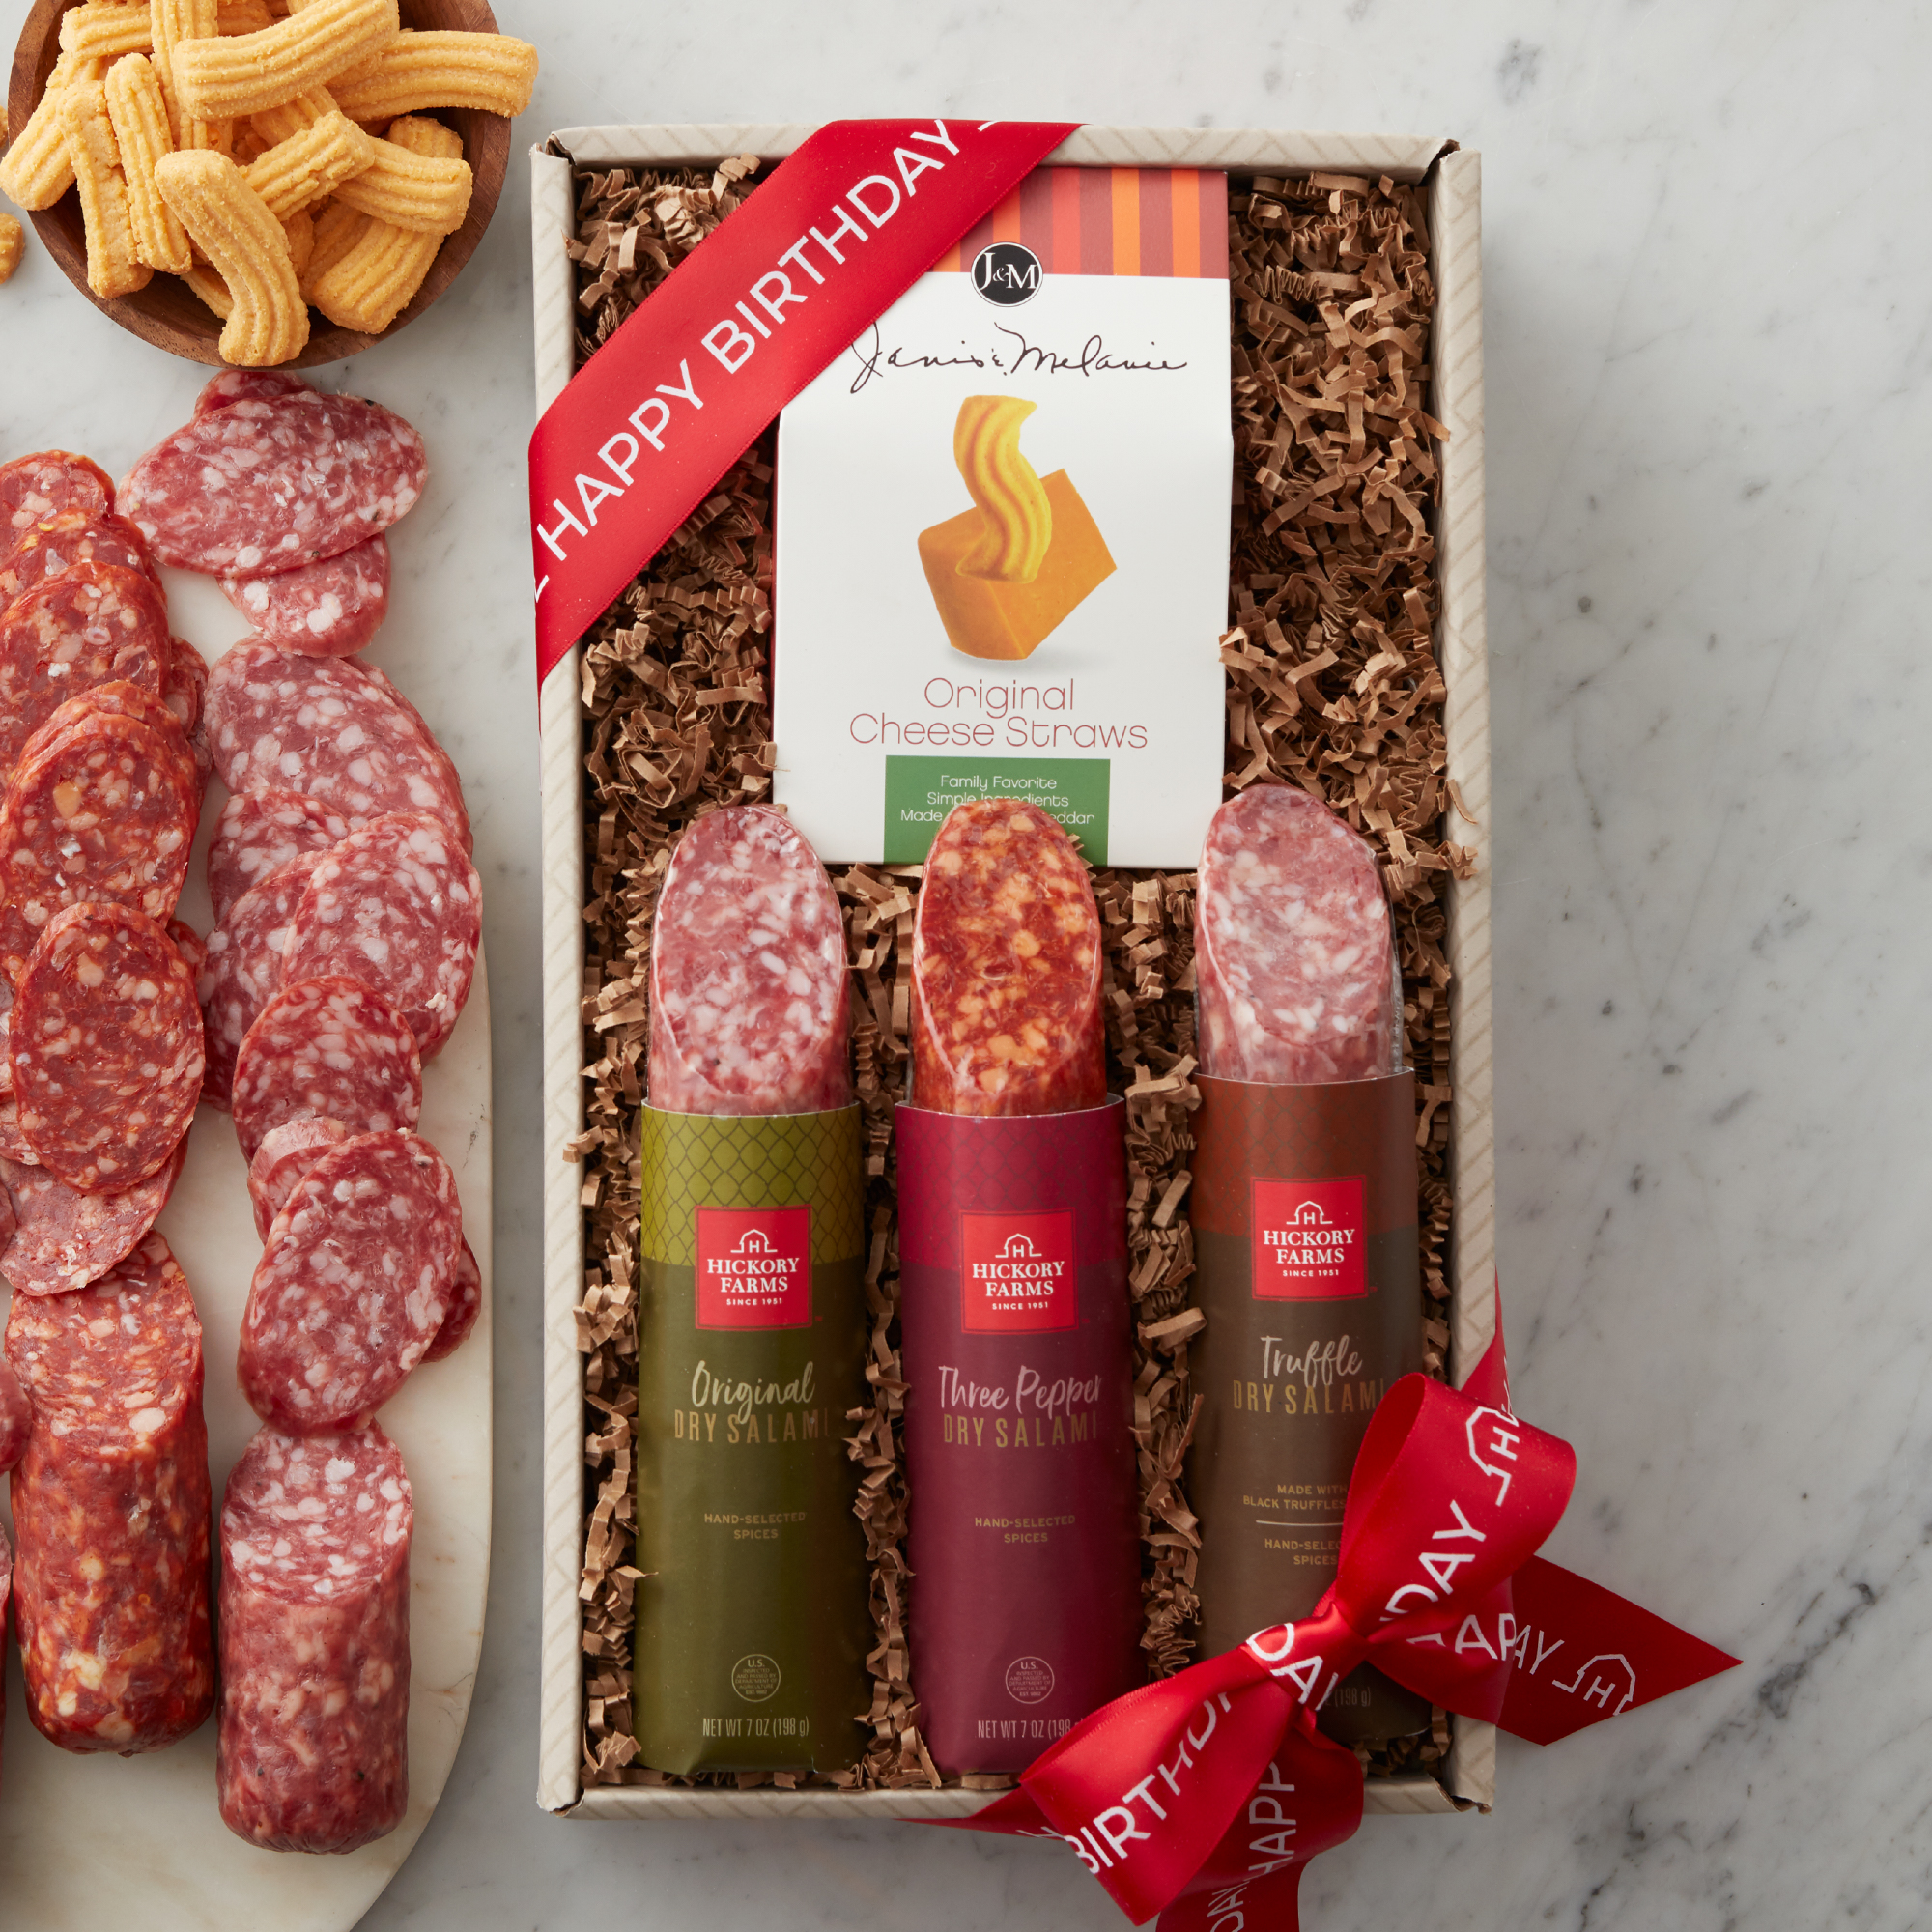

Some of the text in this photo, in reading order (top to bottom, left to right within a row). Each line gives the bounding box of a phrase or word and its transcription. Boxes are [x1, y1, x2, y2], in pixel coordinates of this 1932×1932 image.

[979, 252, 1038, 291] J&M
[537, 119, 960, 560] HAPPY BIRTHDAY
[994, 322, 1188, 377] Melanie
[924, 677, 1074, 719] Original
[850, 713, 1148, 749] Cheese Straws
[941, 775, 1057, 791] Family Favorite
[927, 792, 976, 806] Simple
[901, 810, 1094, 824] Made eddar
[1264, 1229, 1355, 1246] HICKORY
[1276, 1248, 1345, 1264] FARMS
[707, 1258, 800, 1275] HICKORY
[972, 1261, 1065, 1278] HICKORY
[720, 1276, 788, 1293] FARMS
[985, 1280, 1054, 1297] FARMS
[1260, 1334, 1363, 1388] Truffle
[692, 1360, 816, 1425] Original
[938, 1364, 1102, 1420] Three Pepper
[1233, 1378, 1384, 1414] DRY SALAMI
[674, 1407, 830, 1443] DRY SALAMI
[944, 1410, 1097, 1447] DRY SALAMI
[1277, 1484, 1348, 1494] MADE WITH
[1243, 1495, 1346, 1510] BLACK TRUFFLES
[704, 1512, 806, 1524] HAND-SELECTED
[975, 1514, 1076, 1527] HAND-SELECTED
[734, 1529, 779, 1540] SPICES
[1004, 1532, 1048, 1544] SPICES
[1264, 1538, 1342, 1550] HAND-SELEC
[1293, 1555, 1339, 1565] SPICES
[748, 1659, 765, 1667] U.S.
[1020, 1661, 1038, 1669] U.S.
[702, 1716, 810, 1738] NET WT 7 OZ (198 g)
[978, 1720, 997, 1738] NET
[1000, 1720, 1017, 1738] WT
[1020, 1720, 1027, 1738] 7
[1031, 1719, 1044, 1738] OZ
[1047, 1719, 1071, 1740] (198
